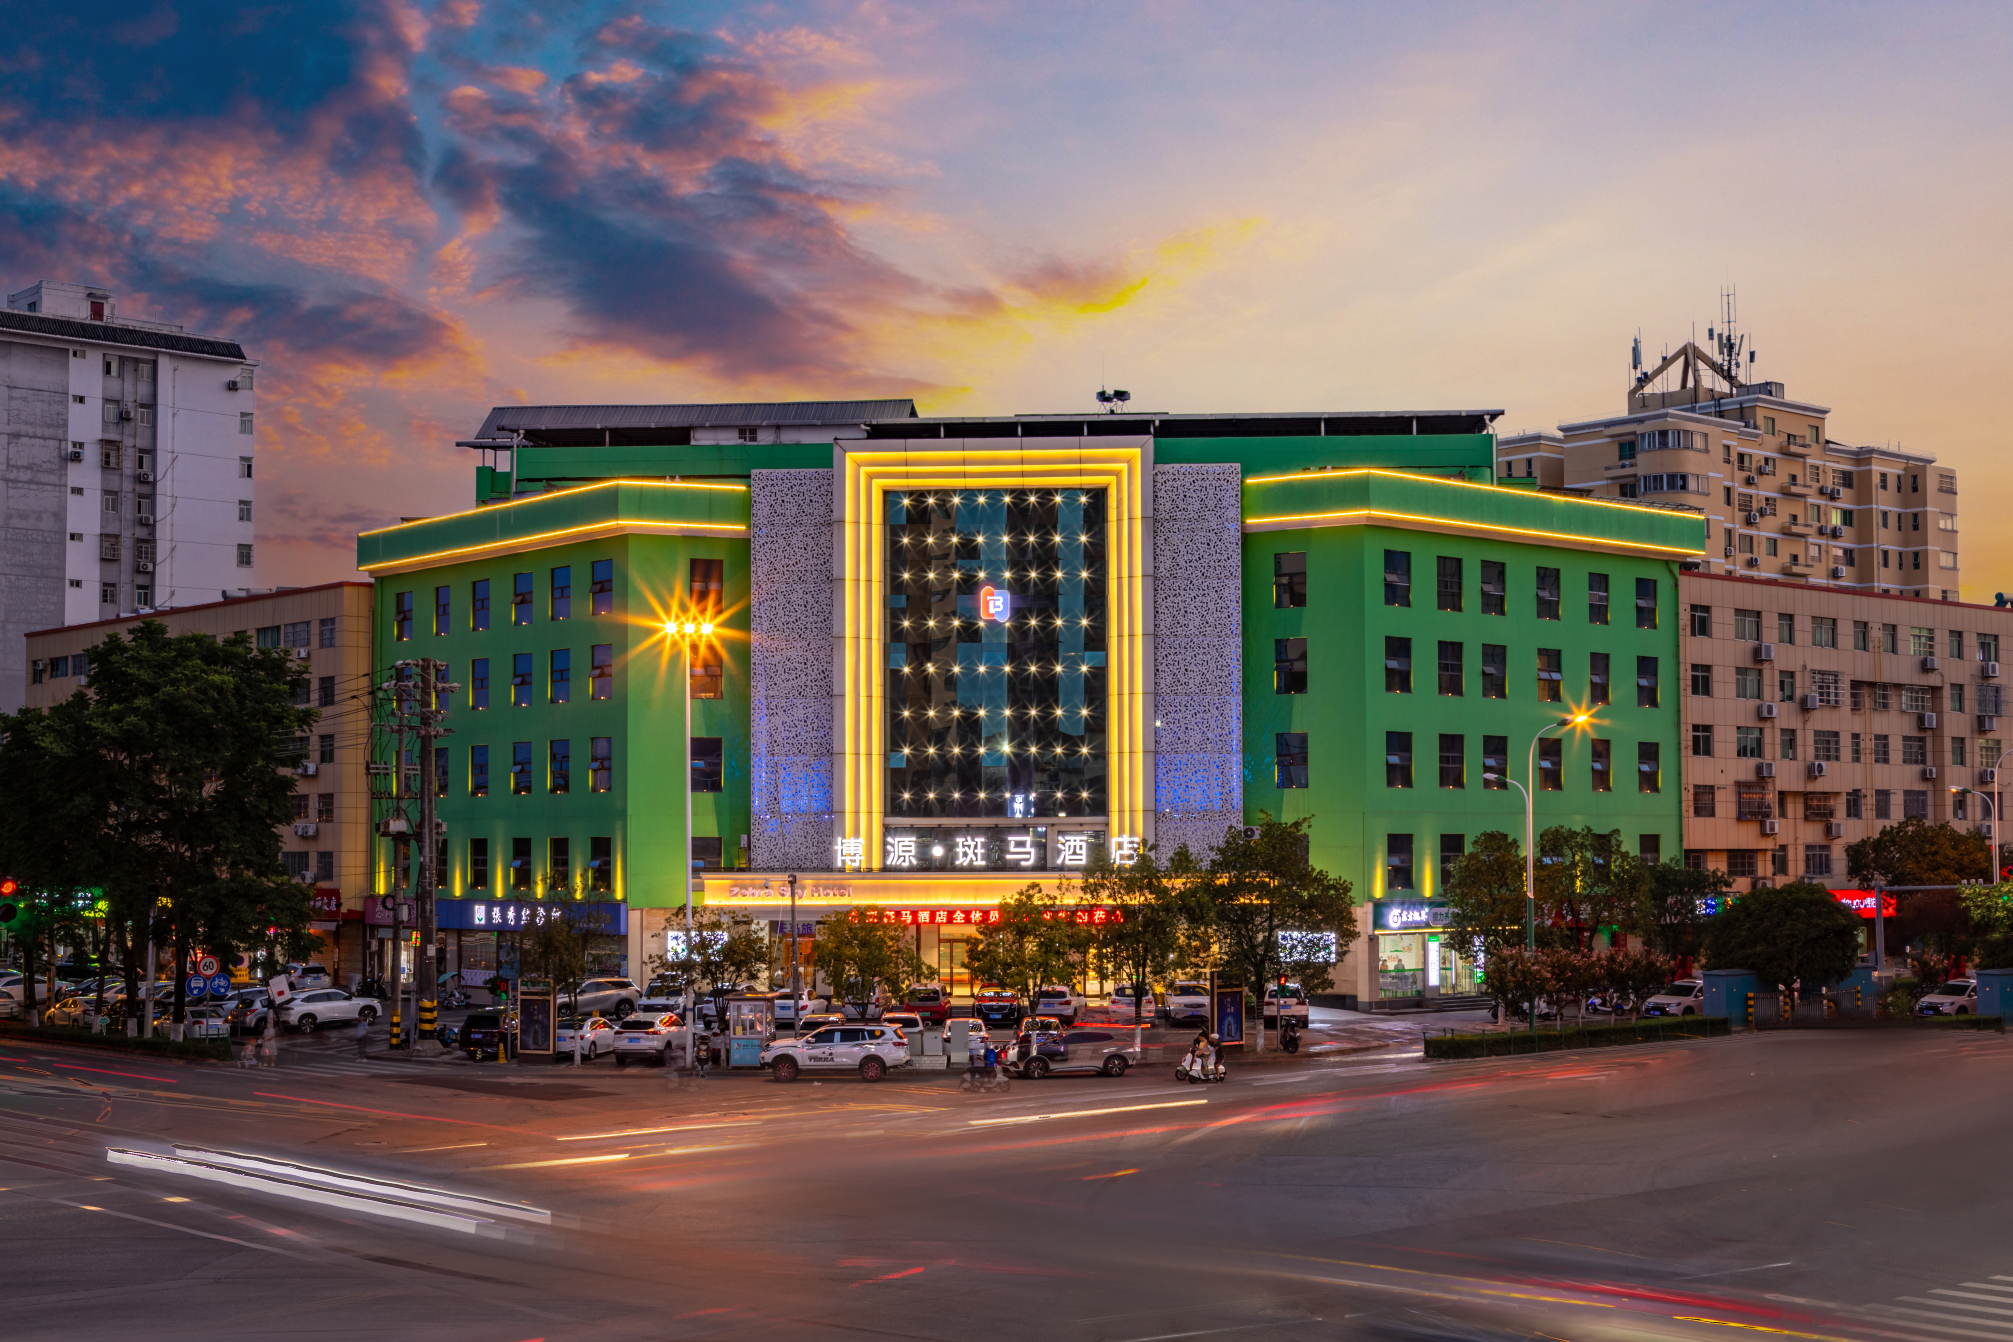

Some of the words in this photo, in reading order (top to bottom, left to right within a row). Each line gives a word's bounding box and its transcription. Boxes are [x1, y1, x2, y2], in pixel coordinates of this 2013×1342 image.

[729, 887, 774, 897] Zebra
[811, 887, 853, 897] Hotel
[202, 960, 215, 972] 60
